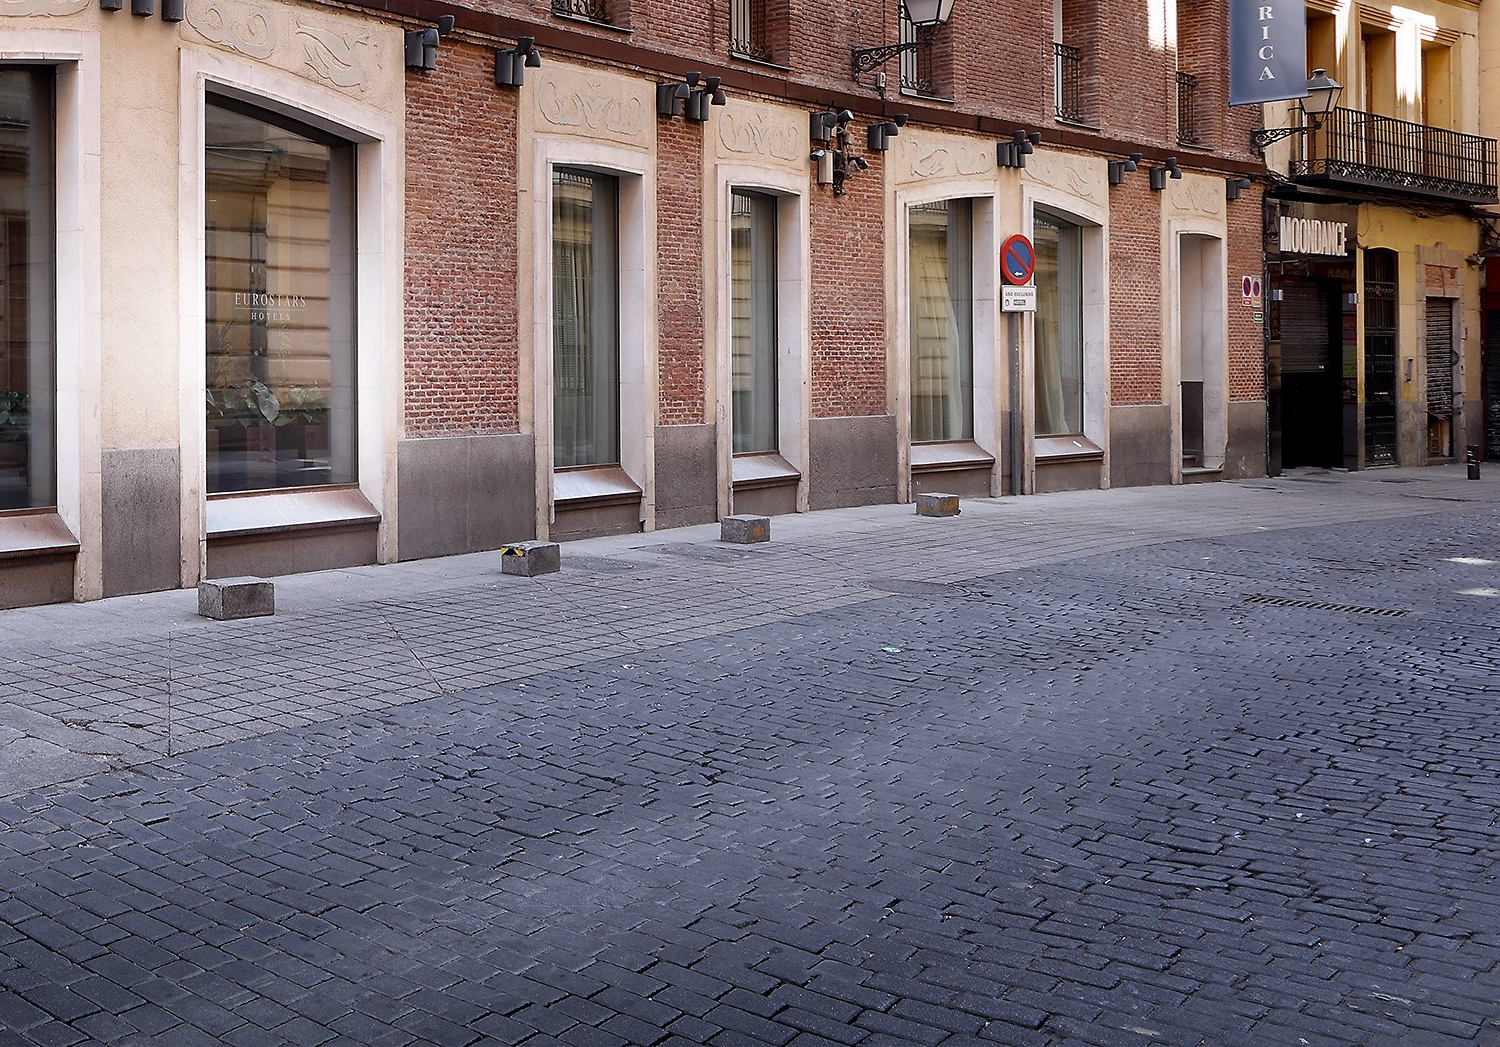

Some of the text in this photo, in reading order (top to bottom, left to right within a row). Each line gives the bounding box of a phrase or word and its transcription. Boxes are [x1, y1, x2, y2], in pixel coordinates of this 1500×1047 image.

[1280, 216, 1348, 257] MOONDANCE
[235, 293, 306, 307] EUROSTARS
[251, 312, 291, 321] HOTELS
